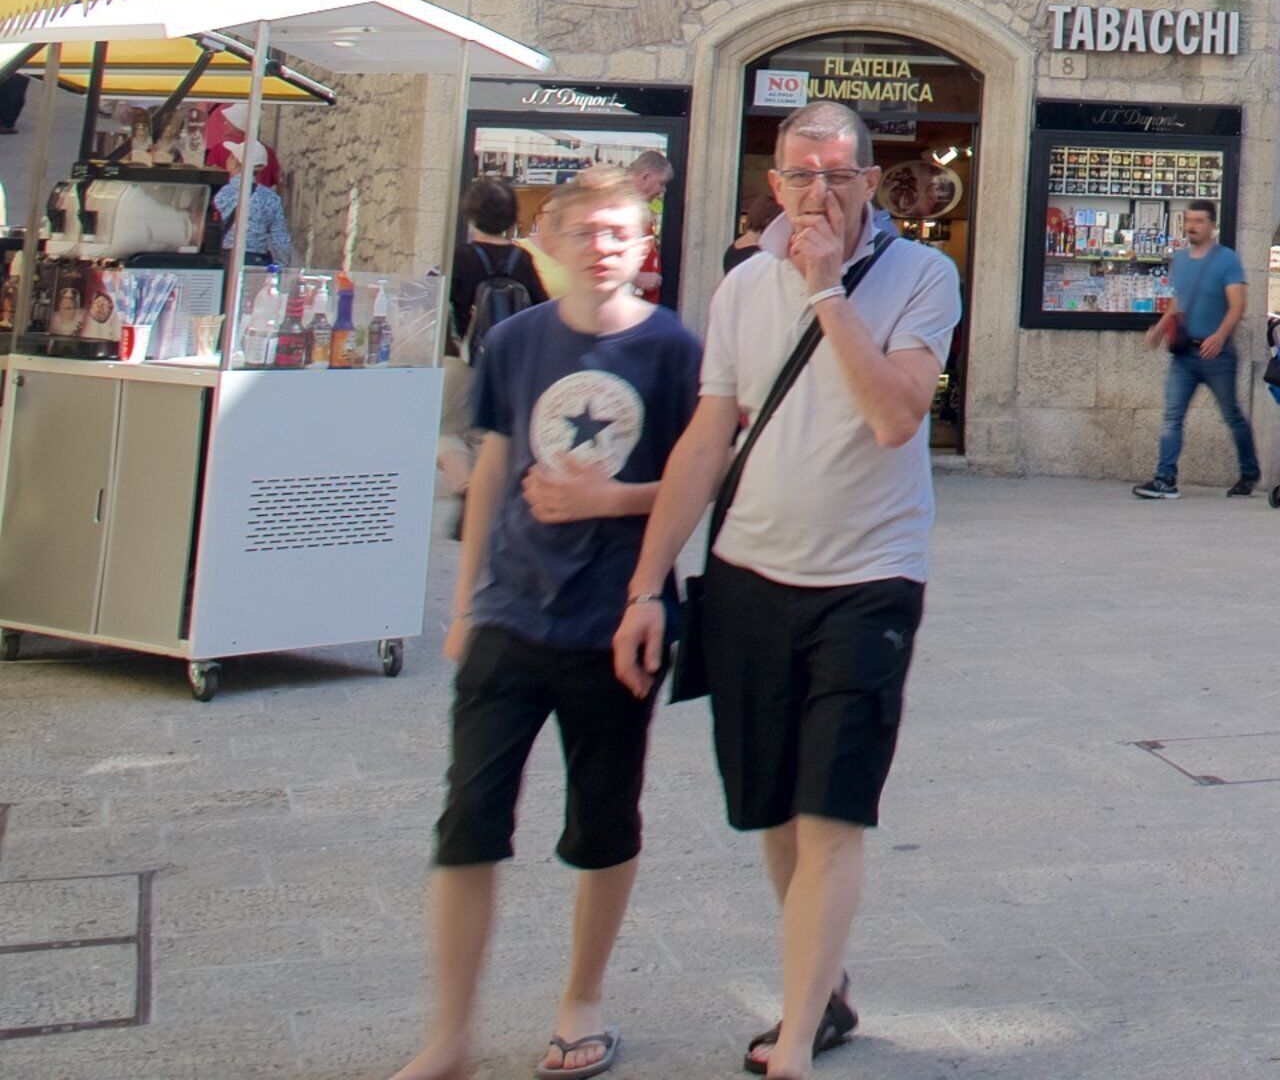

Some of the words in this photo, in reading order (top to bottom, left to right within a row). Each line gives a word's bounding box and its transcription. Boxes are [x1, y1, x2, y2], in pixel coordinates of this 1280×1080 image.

[1048, 4, 1240, 56] TABACCHI
[824, 56, 912, 78] FILATELIA
[1062, 57, 1075, 75] 8
[768, 77, 799, 91] NO
[801, 78, 933, 102] NUMISMATICA
[1123, 109, 1186, 131] Dupont
